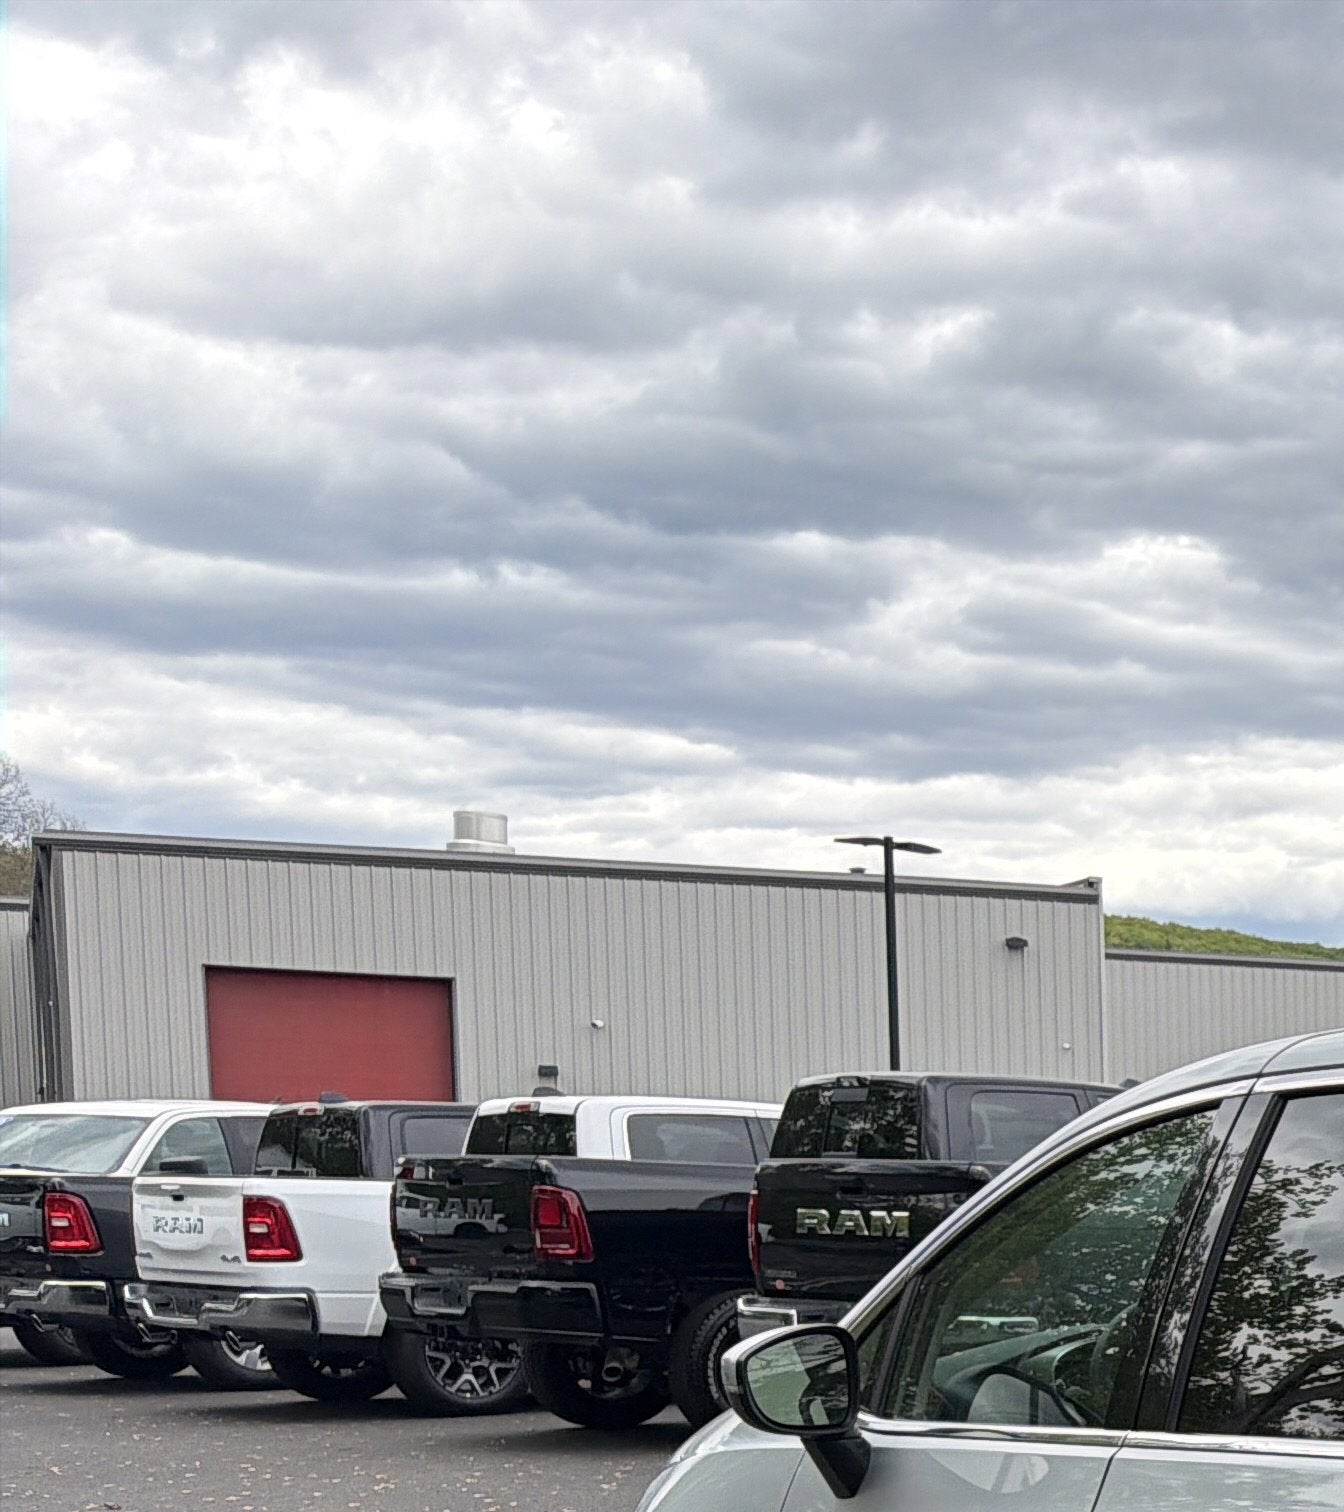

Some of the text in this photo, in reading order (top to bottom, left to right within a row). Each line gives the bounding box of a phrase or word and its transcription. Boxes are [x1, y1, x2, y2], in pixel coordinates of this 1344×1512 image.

[420, 1198, 494, 1219] RAM
[152, 1216, 204, 1234] RAM
[796, 1208, 910, 1237] RAM
